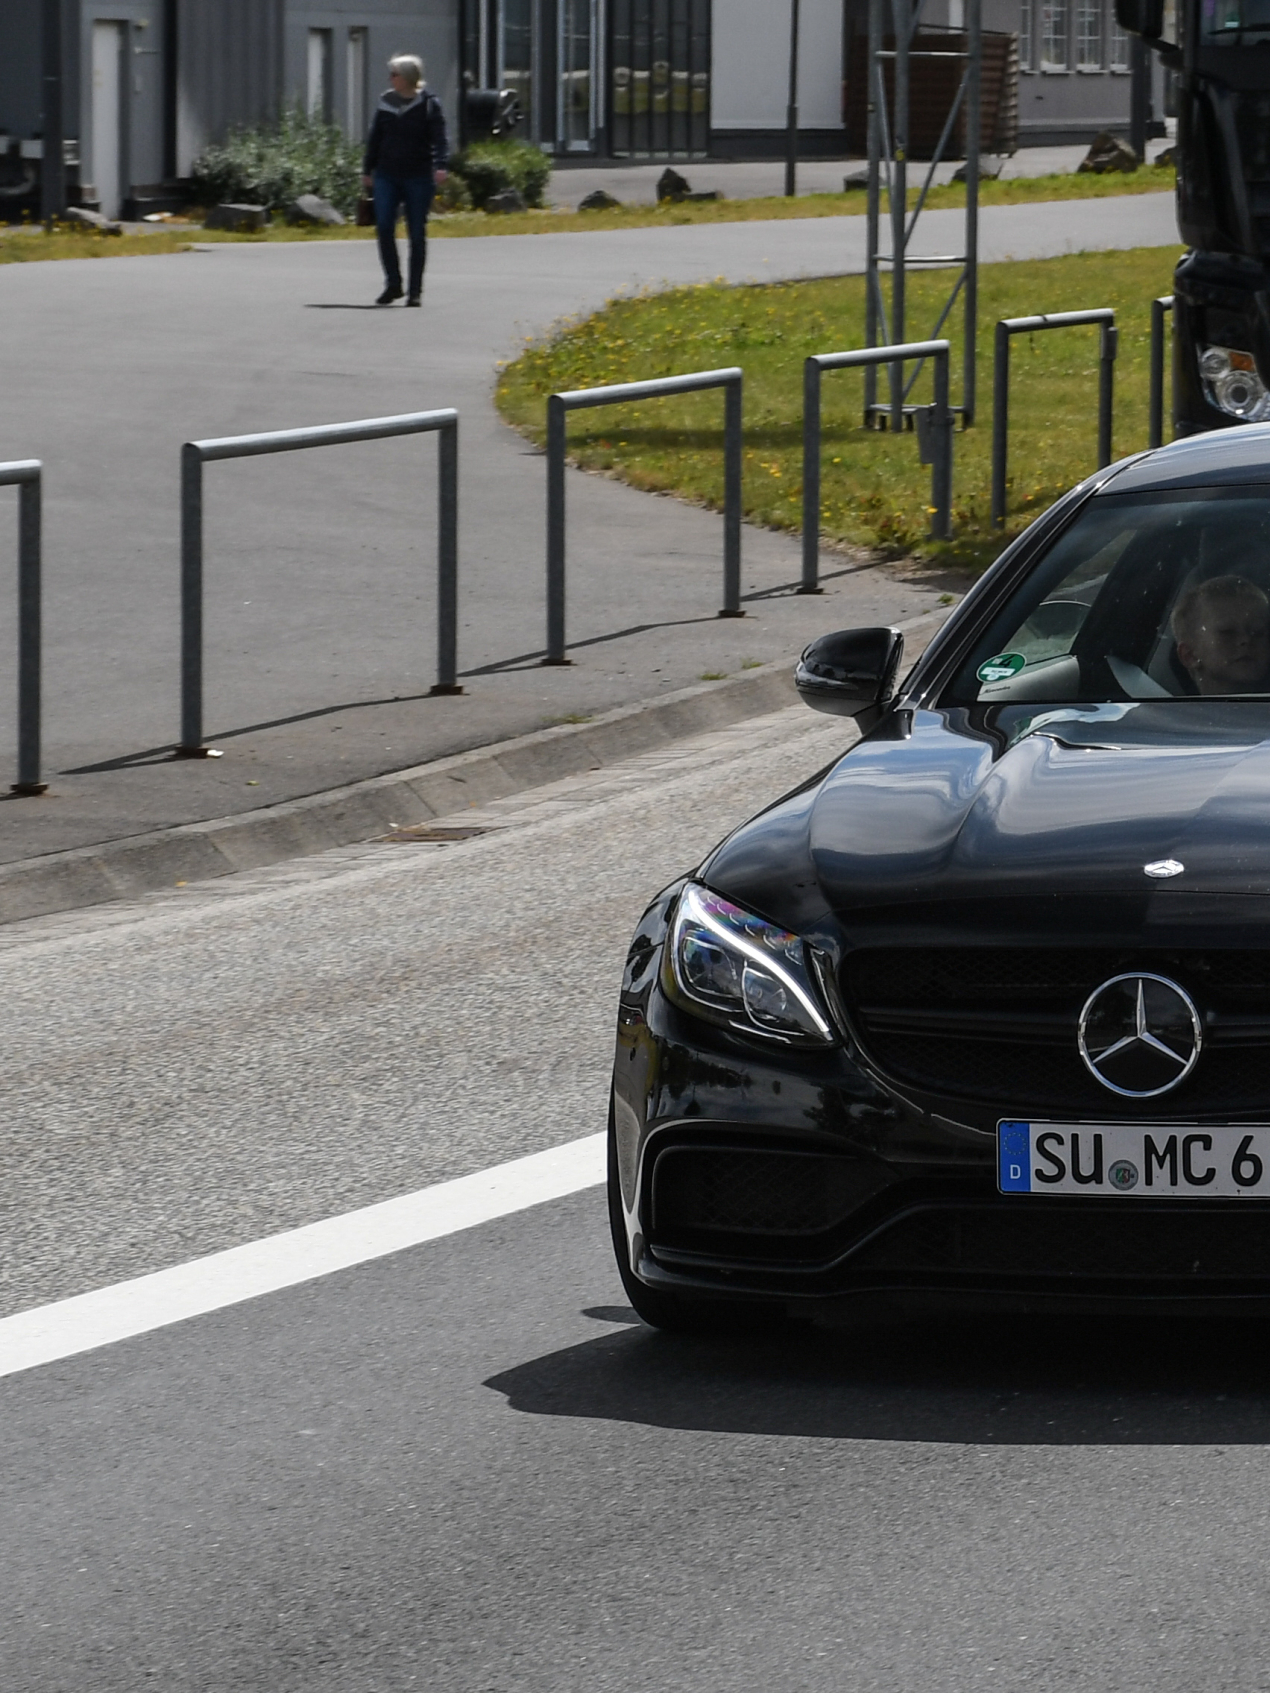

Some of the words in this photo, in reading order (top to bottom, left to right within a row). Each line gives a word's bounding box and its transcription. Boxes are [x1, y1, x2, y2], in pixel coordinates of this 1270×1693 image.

[998, 654, 1016, 668] 4
[1034, 1131, 1104, 1185] SU
[1143, 1133, 1217, 1187] MC
[1231, 1134, 1263, 1187] 6
[1009, 1164, 1021, 1180] D
